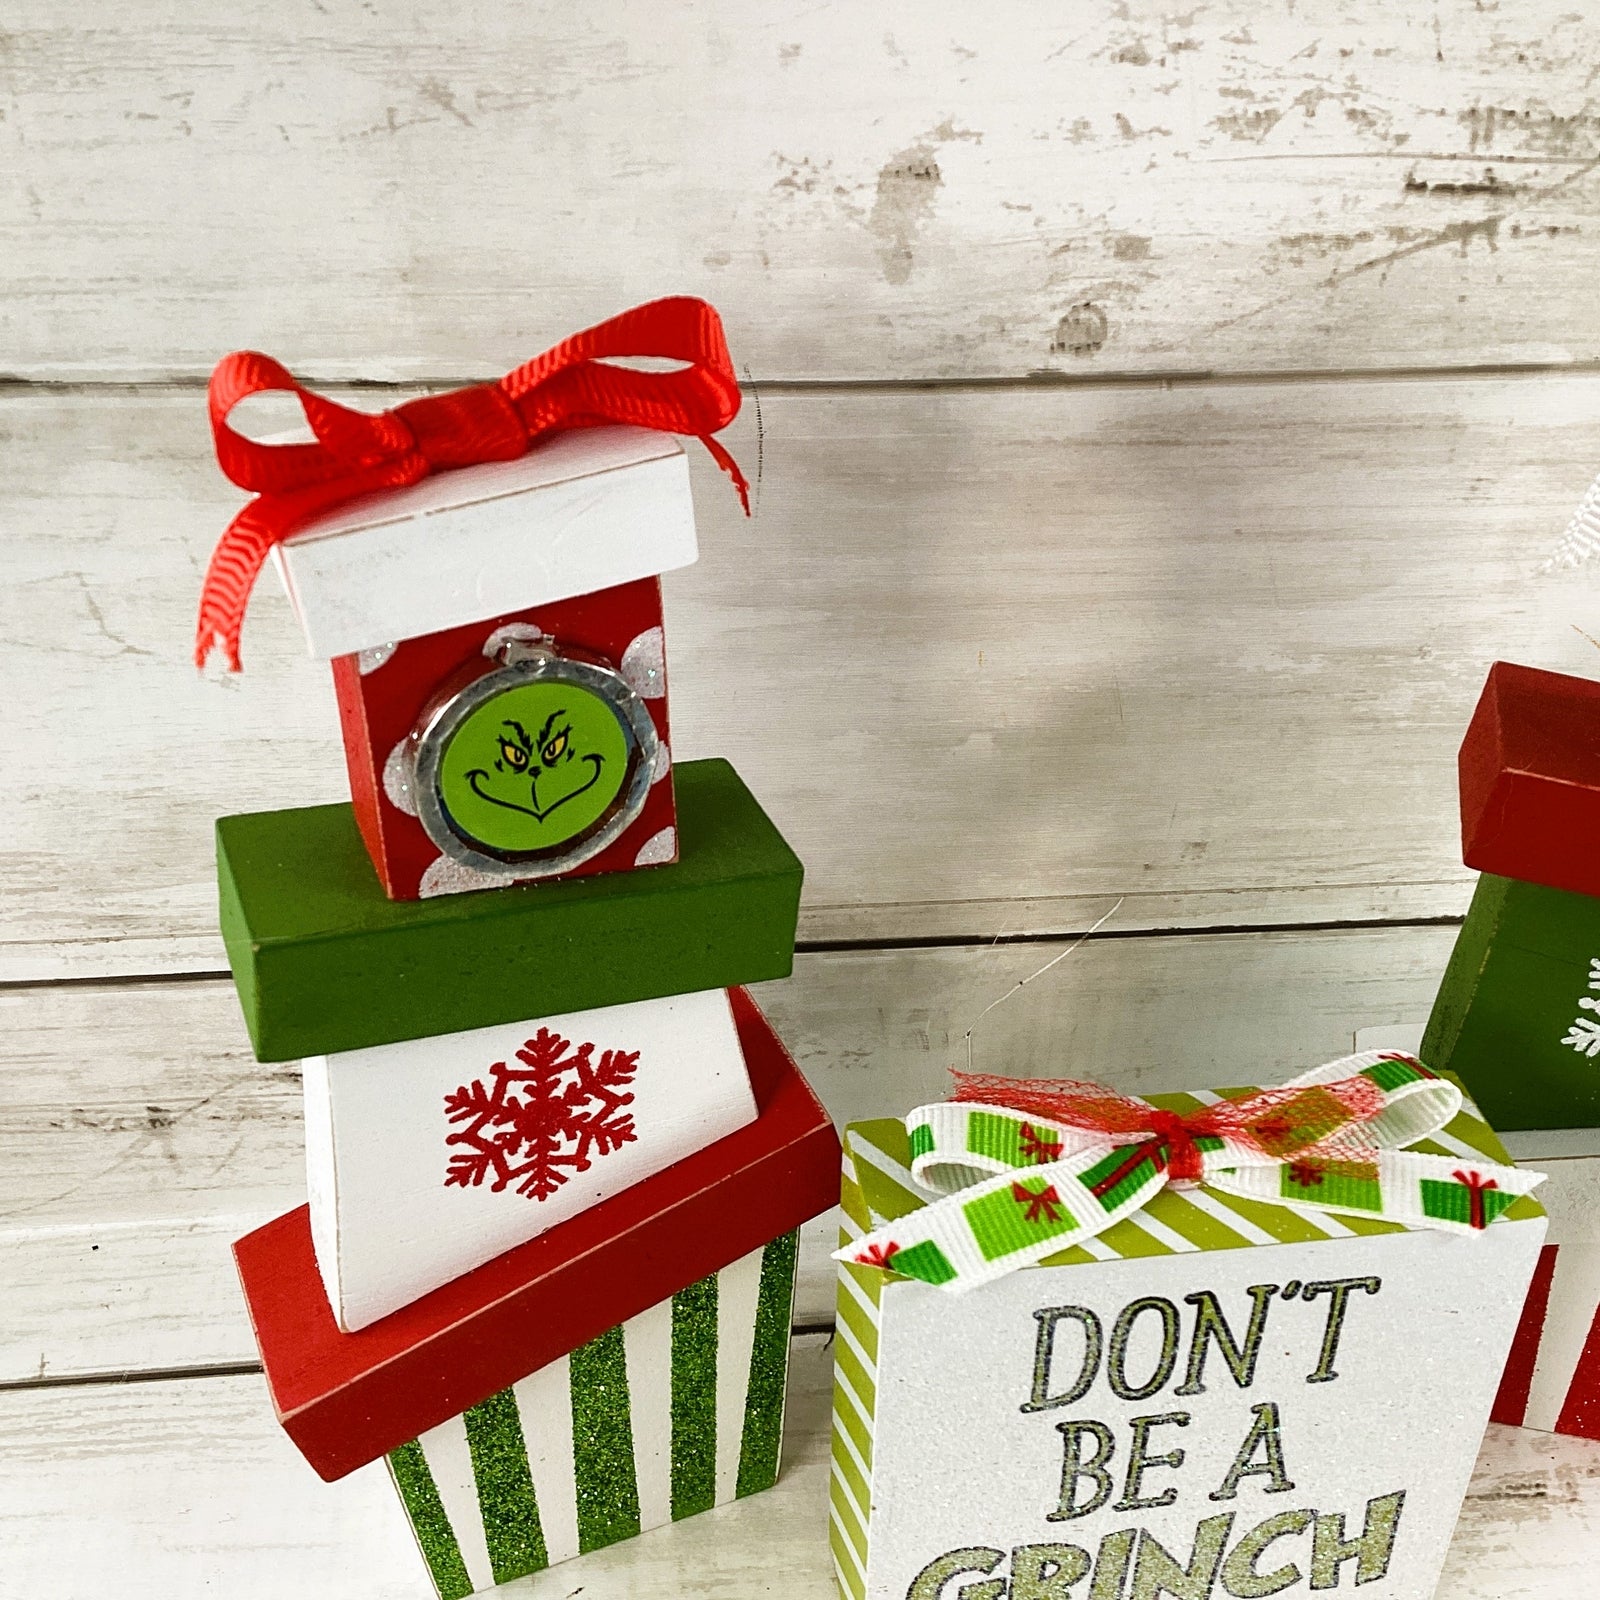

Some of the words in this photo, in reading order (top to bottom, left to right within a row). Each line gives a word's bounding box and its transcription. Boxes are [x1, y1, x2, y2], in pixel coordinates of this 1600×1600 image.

[1020, 1275, 1382, 1413] DON'T
[1046, 1412, 1191, 1523] BE
[1208, 1402, 1295, 1502] A
